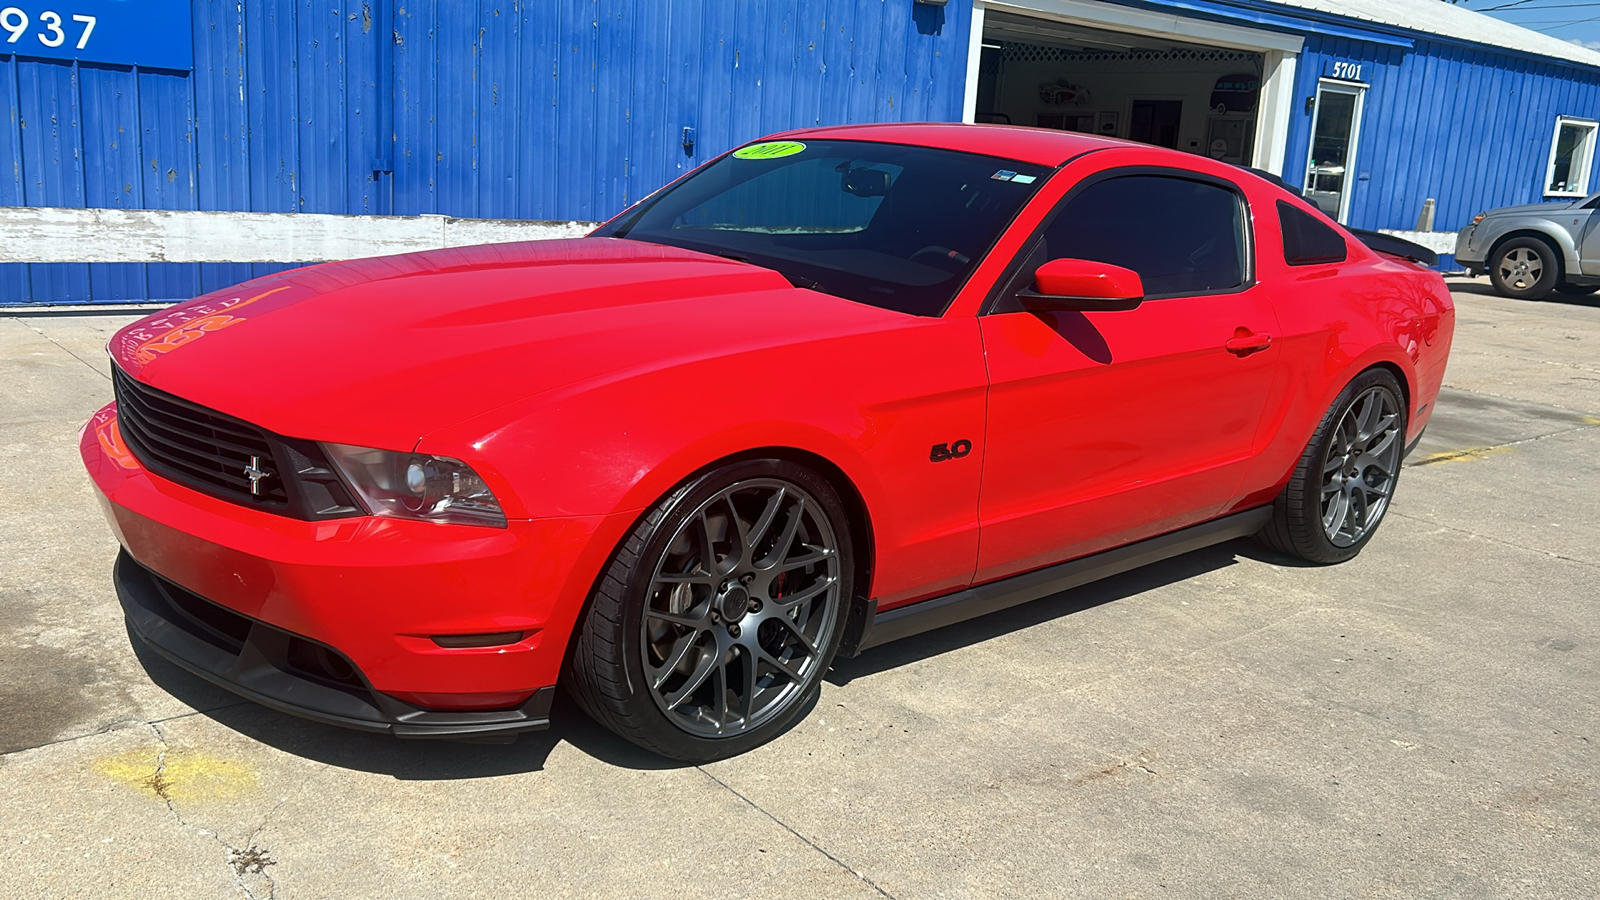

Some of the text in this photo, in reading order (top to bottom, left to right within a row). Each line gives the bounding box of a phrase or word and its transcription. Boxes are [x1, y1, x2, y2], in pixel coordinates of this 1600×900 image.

[0, 7, 97, 50] 937
[1332, 61, 1362, 80] 5701
[929, 439, 972, 463] 5.0
